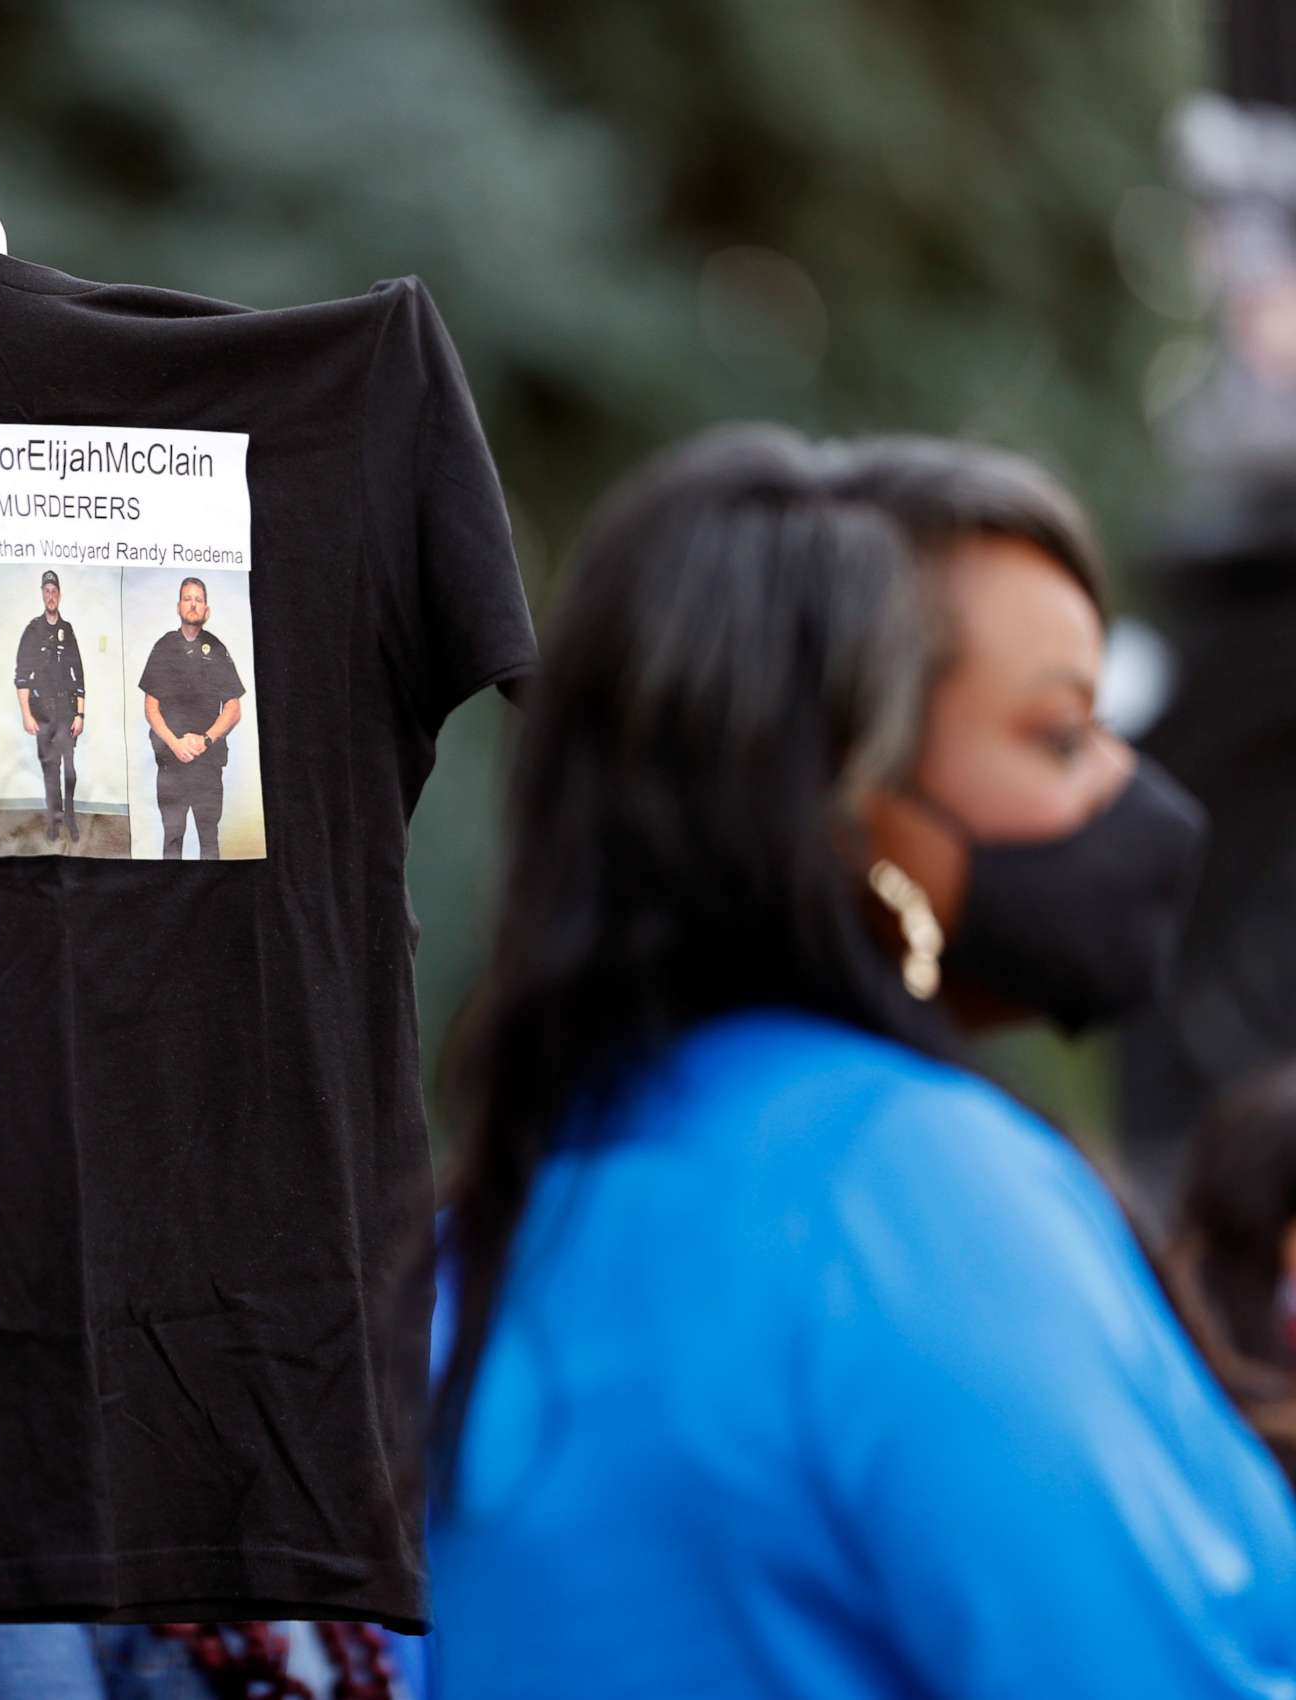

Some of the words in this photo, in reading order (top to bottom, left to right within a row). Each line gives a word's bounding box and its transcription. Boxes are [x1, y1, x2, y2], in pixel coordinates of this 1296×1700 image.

[41, 540, 110, 563] Woodyard
[116, 542, 167, 565] Randy
[173, 544, 244, 564] Roedema
